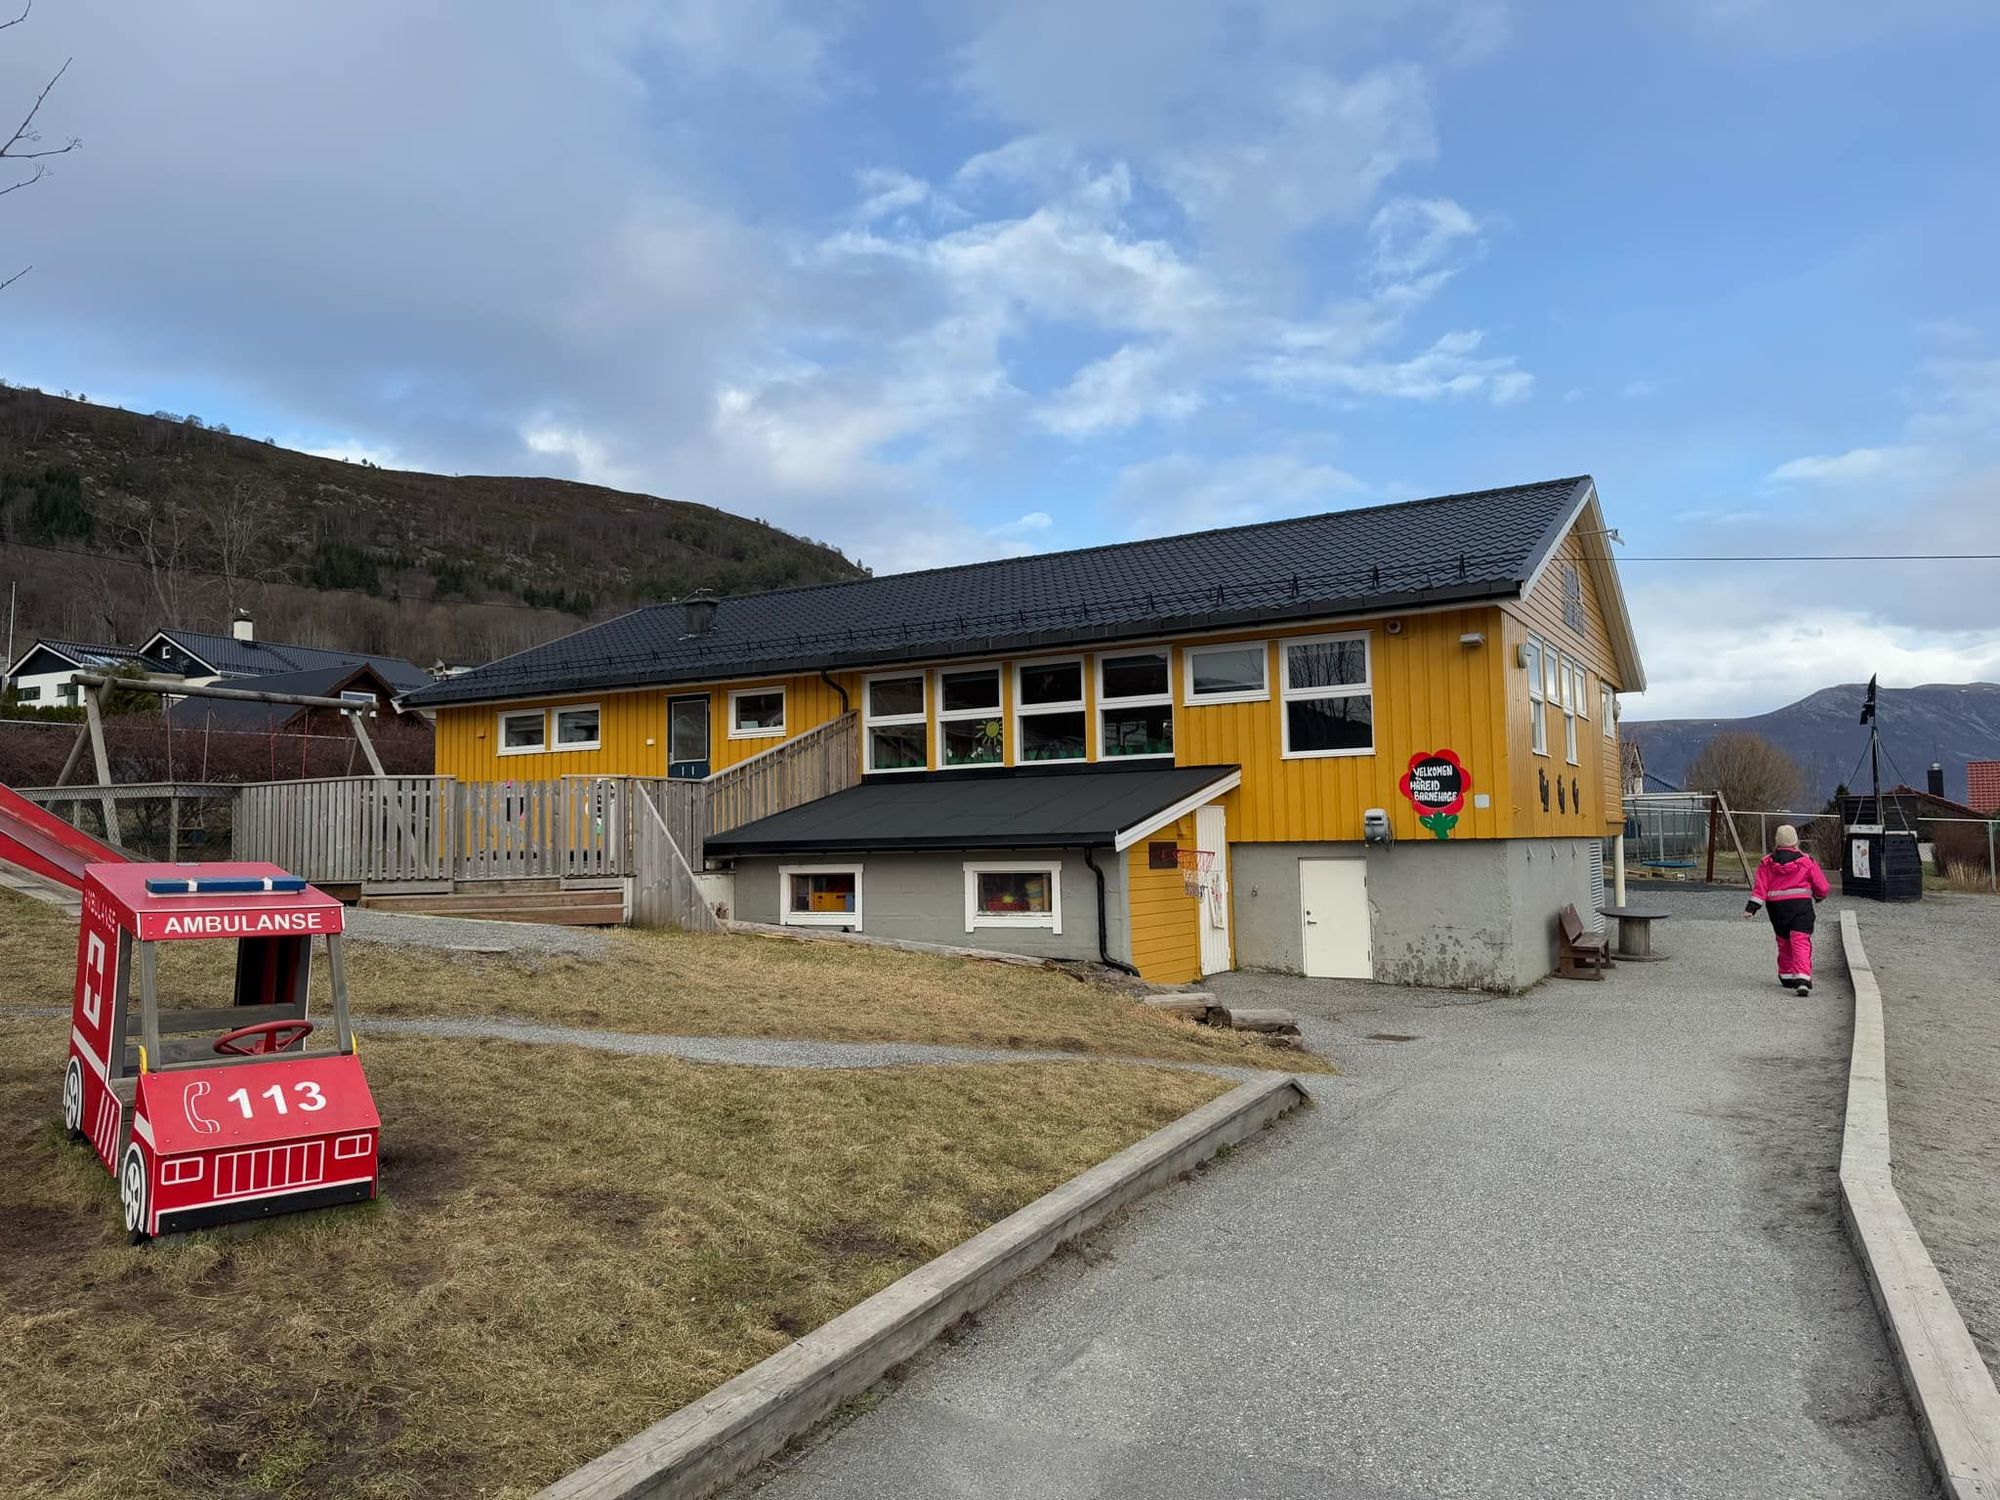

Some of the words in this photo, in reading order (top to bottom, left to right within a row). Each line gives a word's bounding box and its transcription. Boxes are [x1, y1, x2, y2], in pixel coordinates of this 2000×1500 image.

[1412, 765, 1453, 777] VELKOMEN
[1413, 791, 1458, 802] BARNEHAGE
[164, 912, 322, 934] AMBULANSE
[227, 1081, 327, 1119] 113
